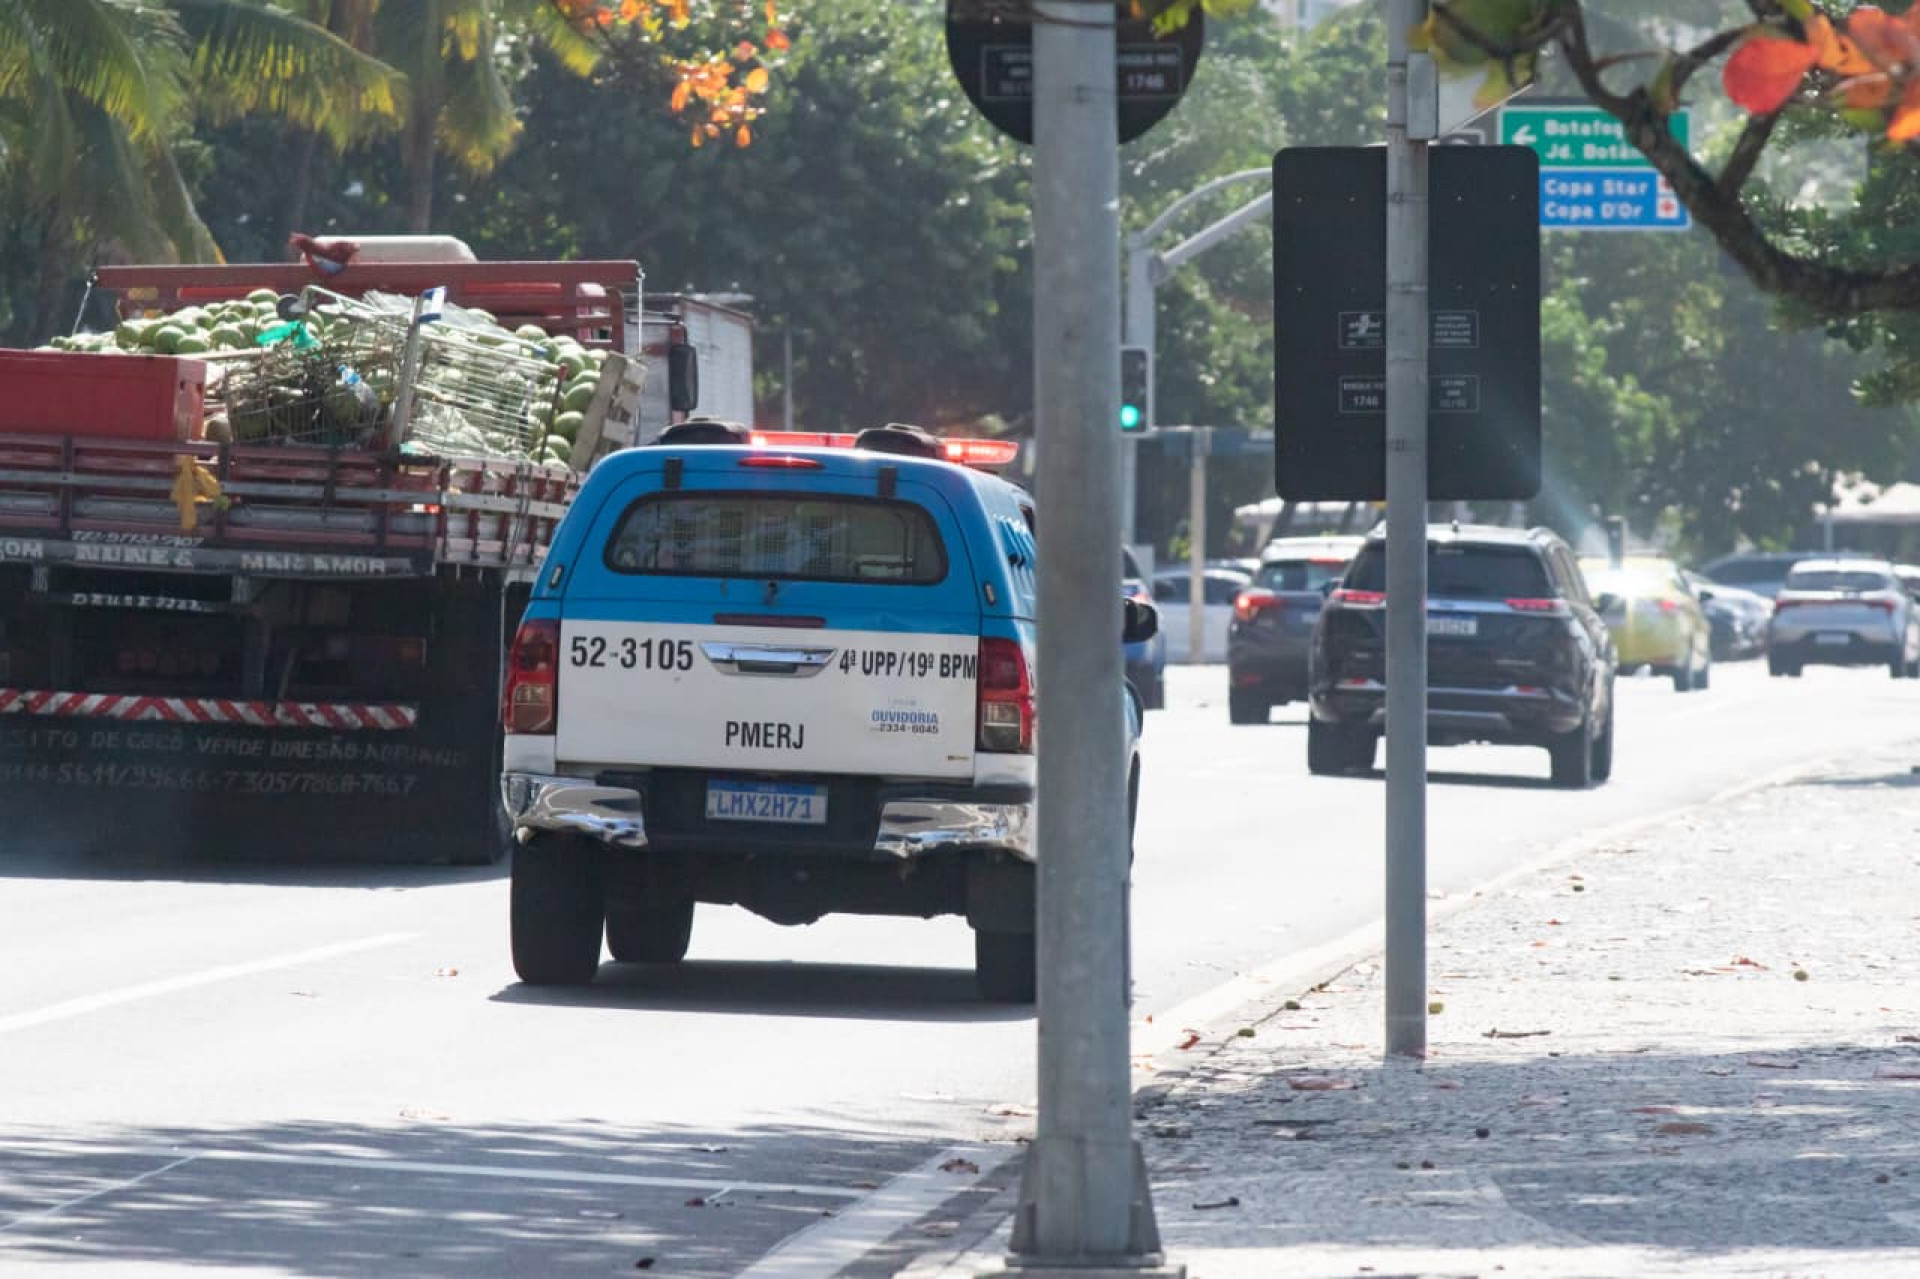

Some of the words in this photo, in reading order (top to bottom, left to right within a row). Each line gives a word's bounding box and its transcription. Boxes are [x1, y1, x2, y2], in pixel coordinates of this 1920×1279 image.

[1545, 118, 1624, 141] Botafog
[1546, 143, 1575, 160] Jd.
[1583, 141, 1648, 160] Botân
[1544, 179, 1594, 198] Copa
[1603, 179, 1648, 196] Star
[1544, 203, 1594, 221] Copa
[0, 540, 44, 559] OM
[571, 636, 693, 671] 52-3105
[938, 655, 977, 680] BPM
[871, 710, 938, 724] OUVIDORIA
[725, 720, 805, 750] PMERJ
